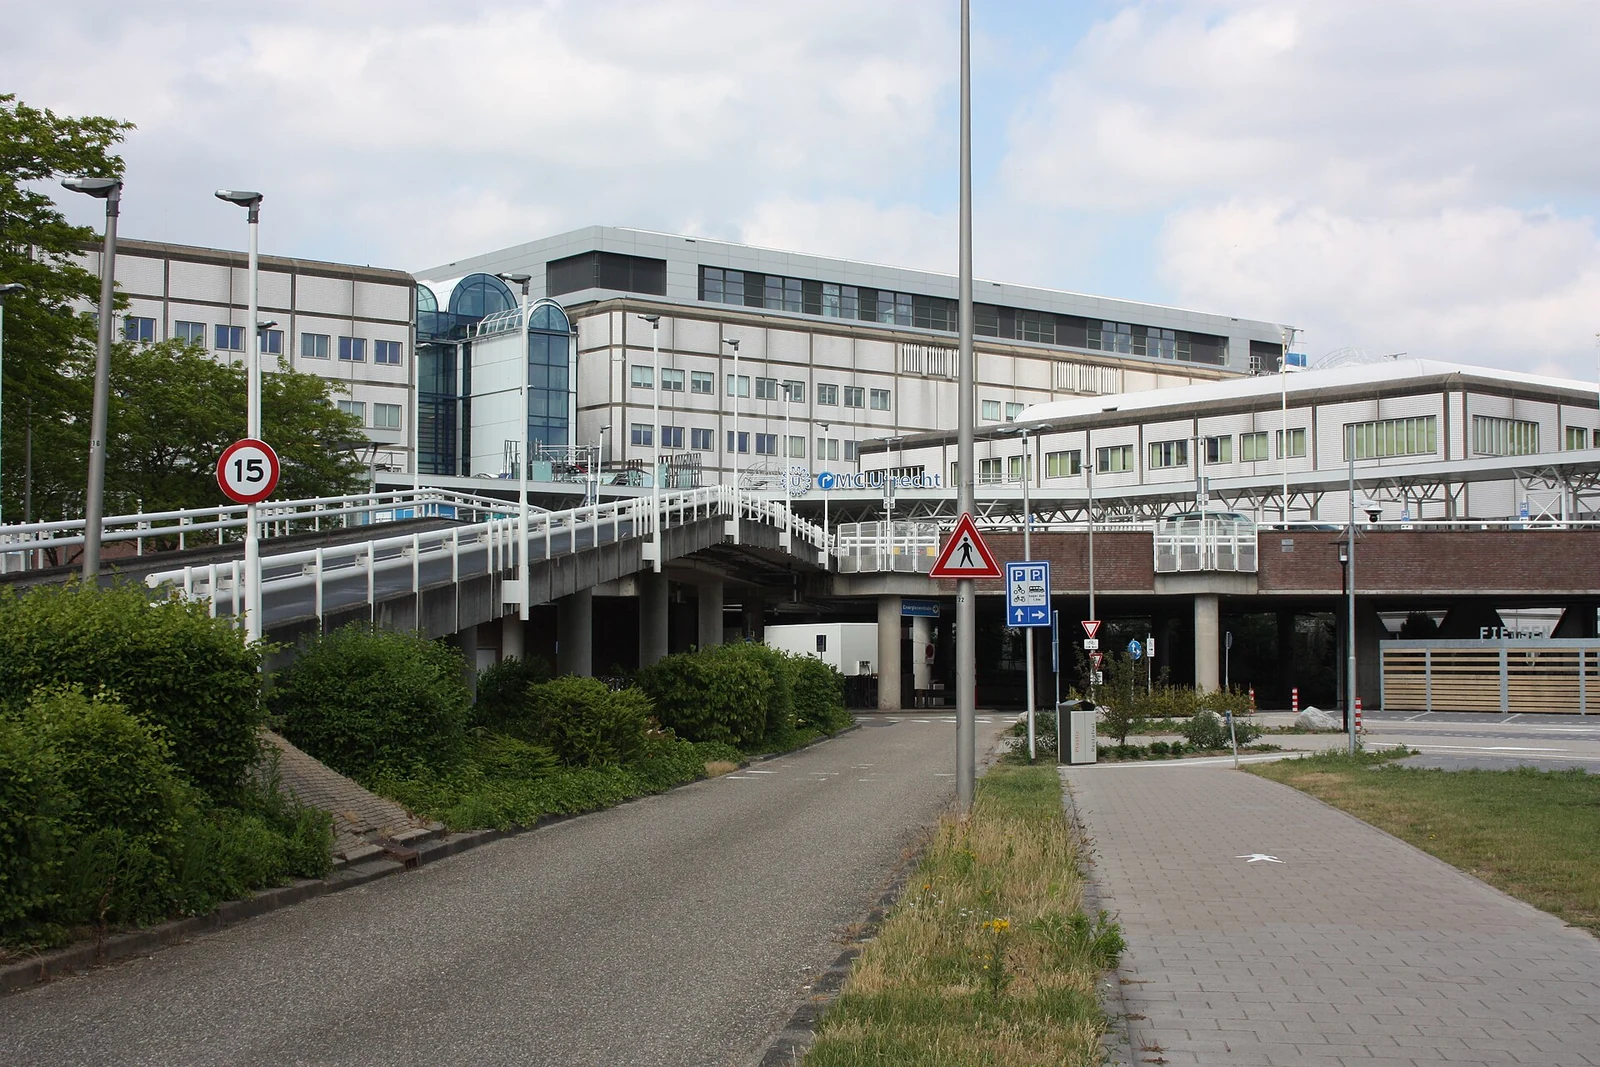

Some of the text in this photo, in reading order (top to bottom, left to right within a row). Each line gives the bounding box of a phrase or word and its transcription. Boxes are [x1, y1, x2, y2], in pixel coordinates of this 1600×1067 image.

[234, 458, 264, 483] 15
[834, 472, 865, 489] MC
[1480, 626, 1551, 640] FIETSEN
